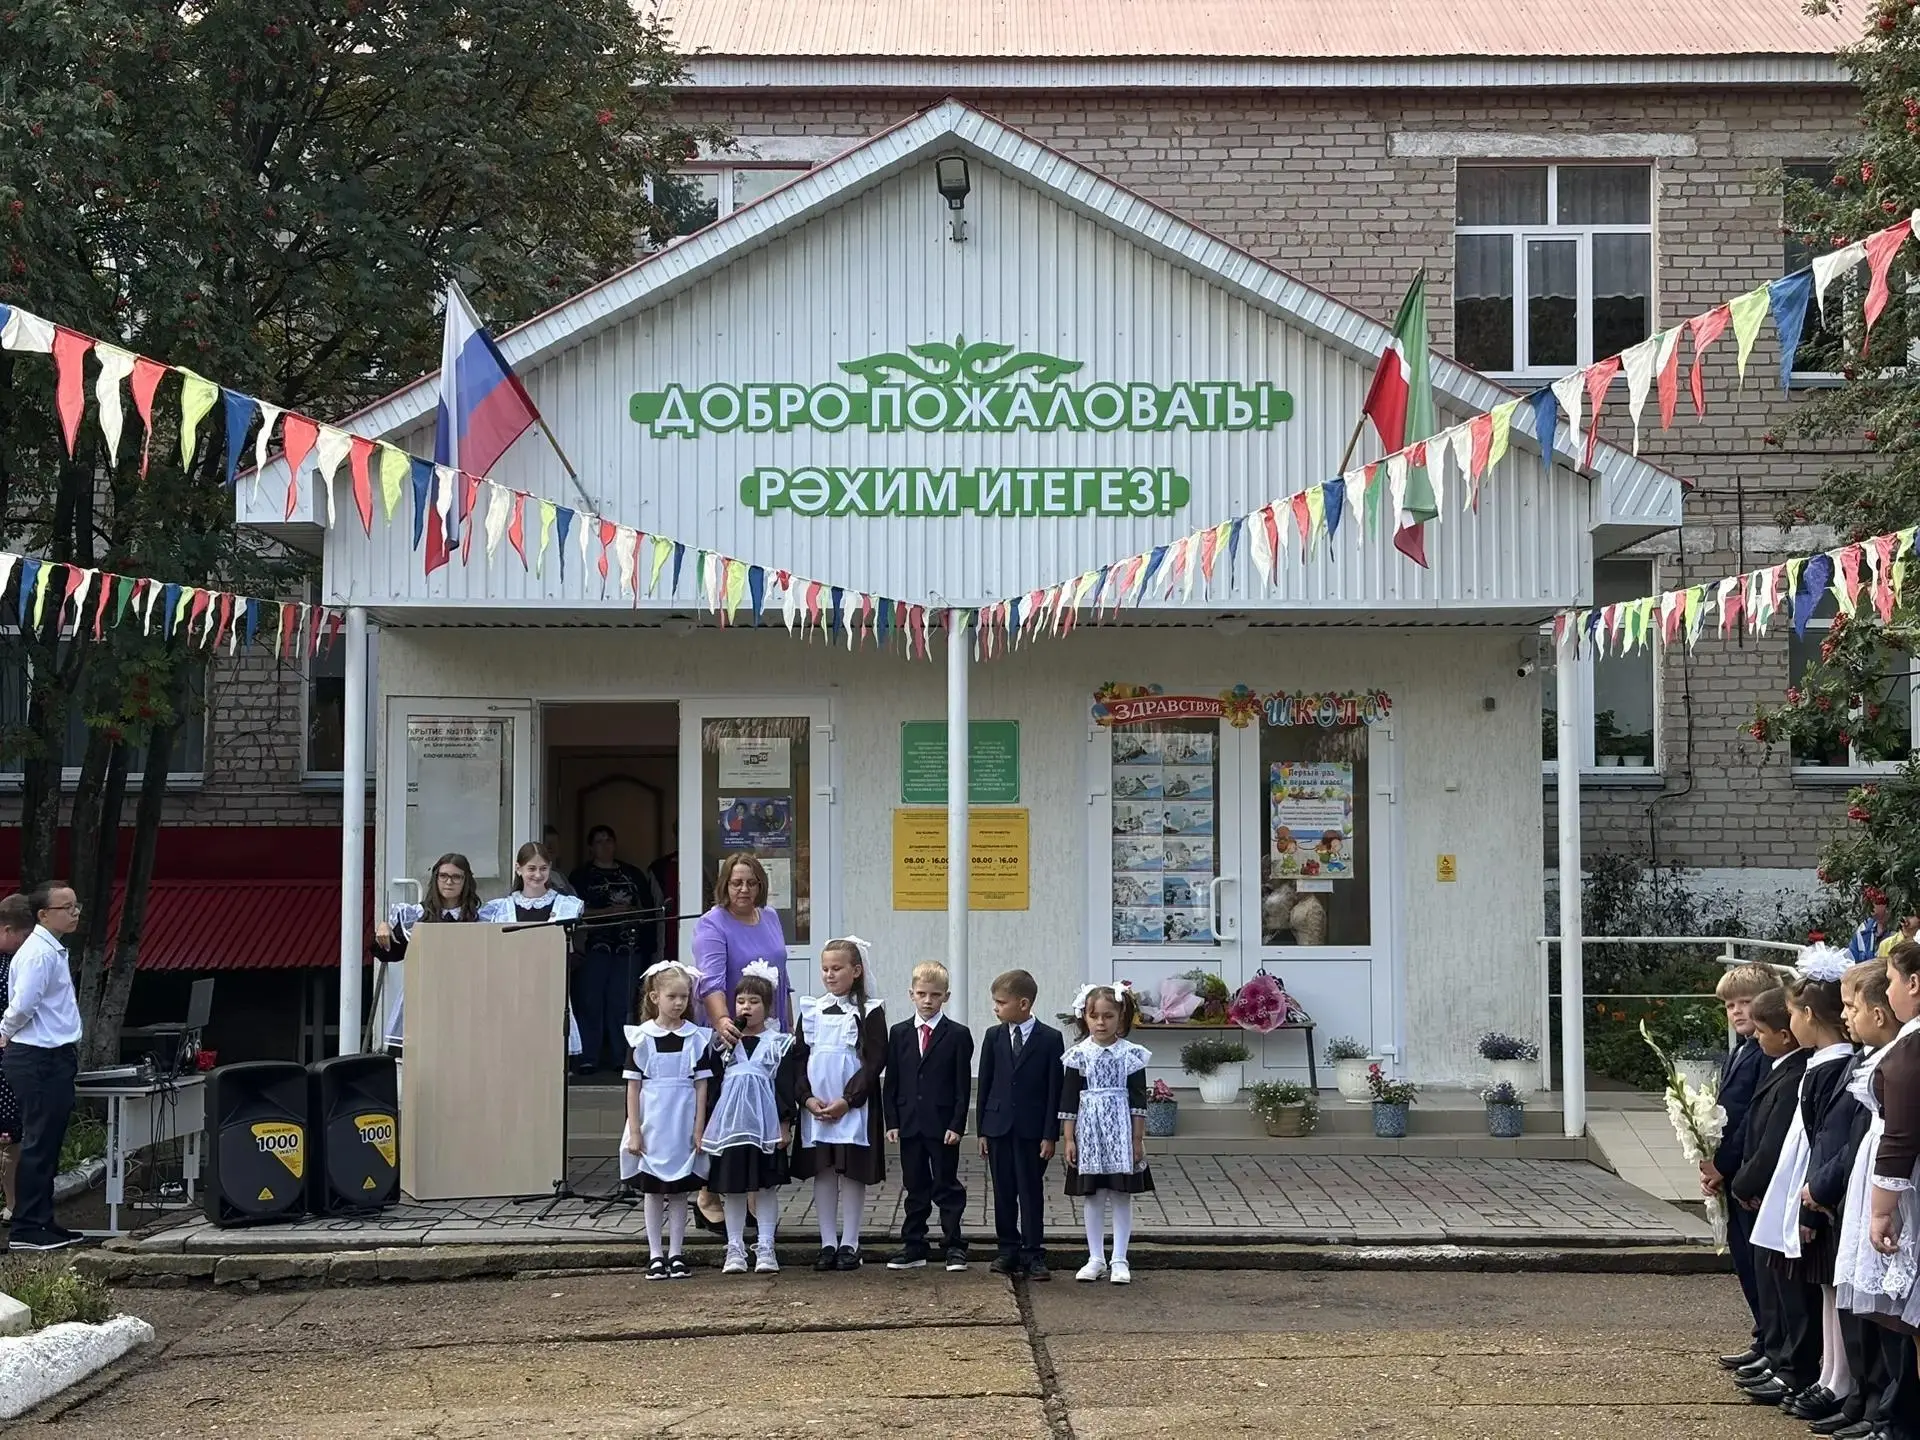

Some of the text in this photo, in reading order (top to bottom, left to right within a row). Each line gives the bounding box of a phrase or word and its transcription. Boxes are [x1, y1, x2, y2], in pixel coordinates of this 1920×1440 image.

[654, 386, 1269, 433] ДОБРО ПОЖАЛОВАТЬ!
[759, 471, 1171, 512] РӘХИМ ИТЕГЕЗ!
[1288, 768, 1319, 777] Первый
[257, 1133, 299, 1152] 1000
[360, 1124, 392, 1143] 1000
